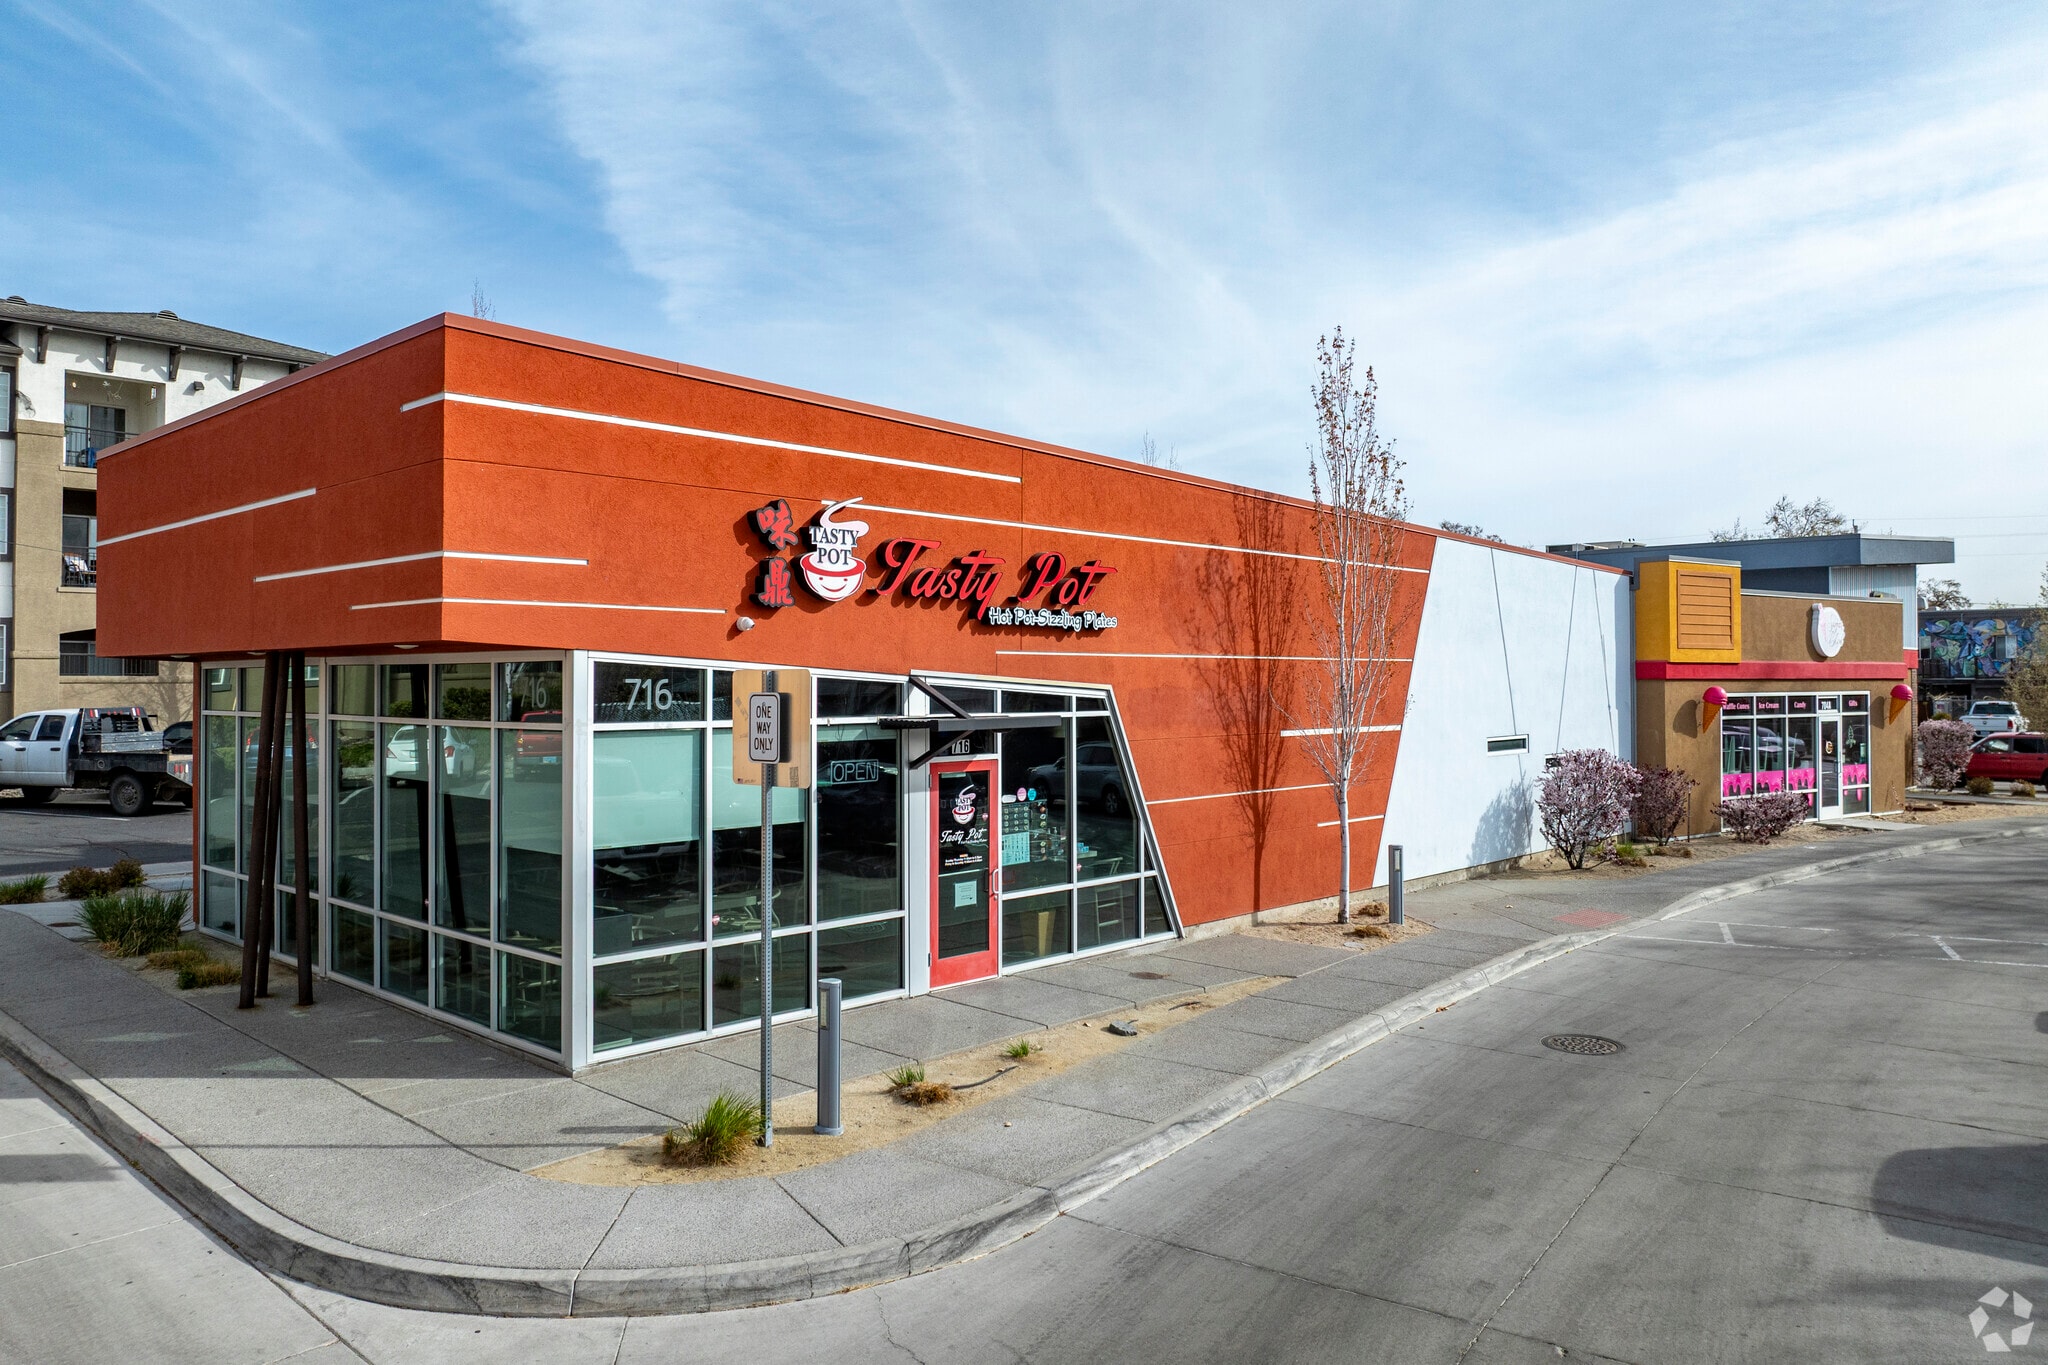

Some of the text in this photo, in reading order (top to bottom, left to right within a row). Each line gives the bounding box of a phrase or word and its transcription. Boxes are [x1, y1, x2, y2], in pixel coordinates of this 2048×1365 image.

[810, 526, 859, 547] TASTY
[817, 547, 852, 565] POT
[876, 537, 1118, 619] Tasty Pot
[989, 607, 1012, 625] Hot
[1084, 611, 1118, 630] Plates
[624, 678, 673, 711] 716
[756, 705, 772, 719] ONE
[1793, 701, 1807, 710] Candy
[756, 721, 771, 735] WAY
[754, 737, 773, 751] ONLY
[833, 762, 876, 782] OPEN
[940, 829, 965, 845] Tasty
[965, 827, 988, 840] Pot
